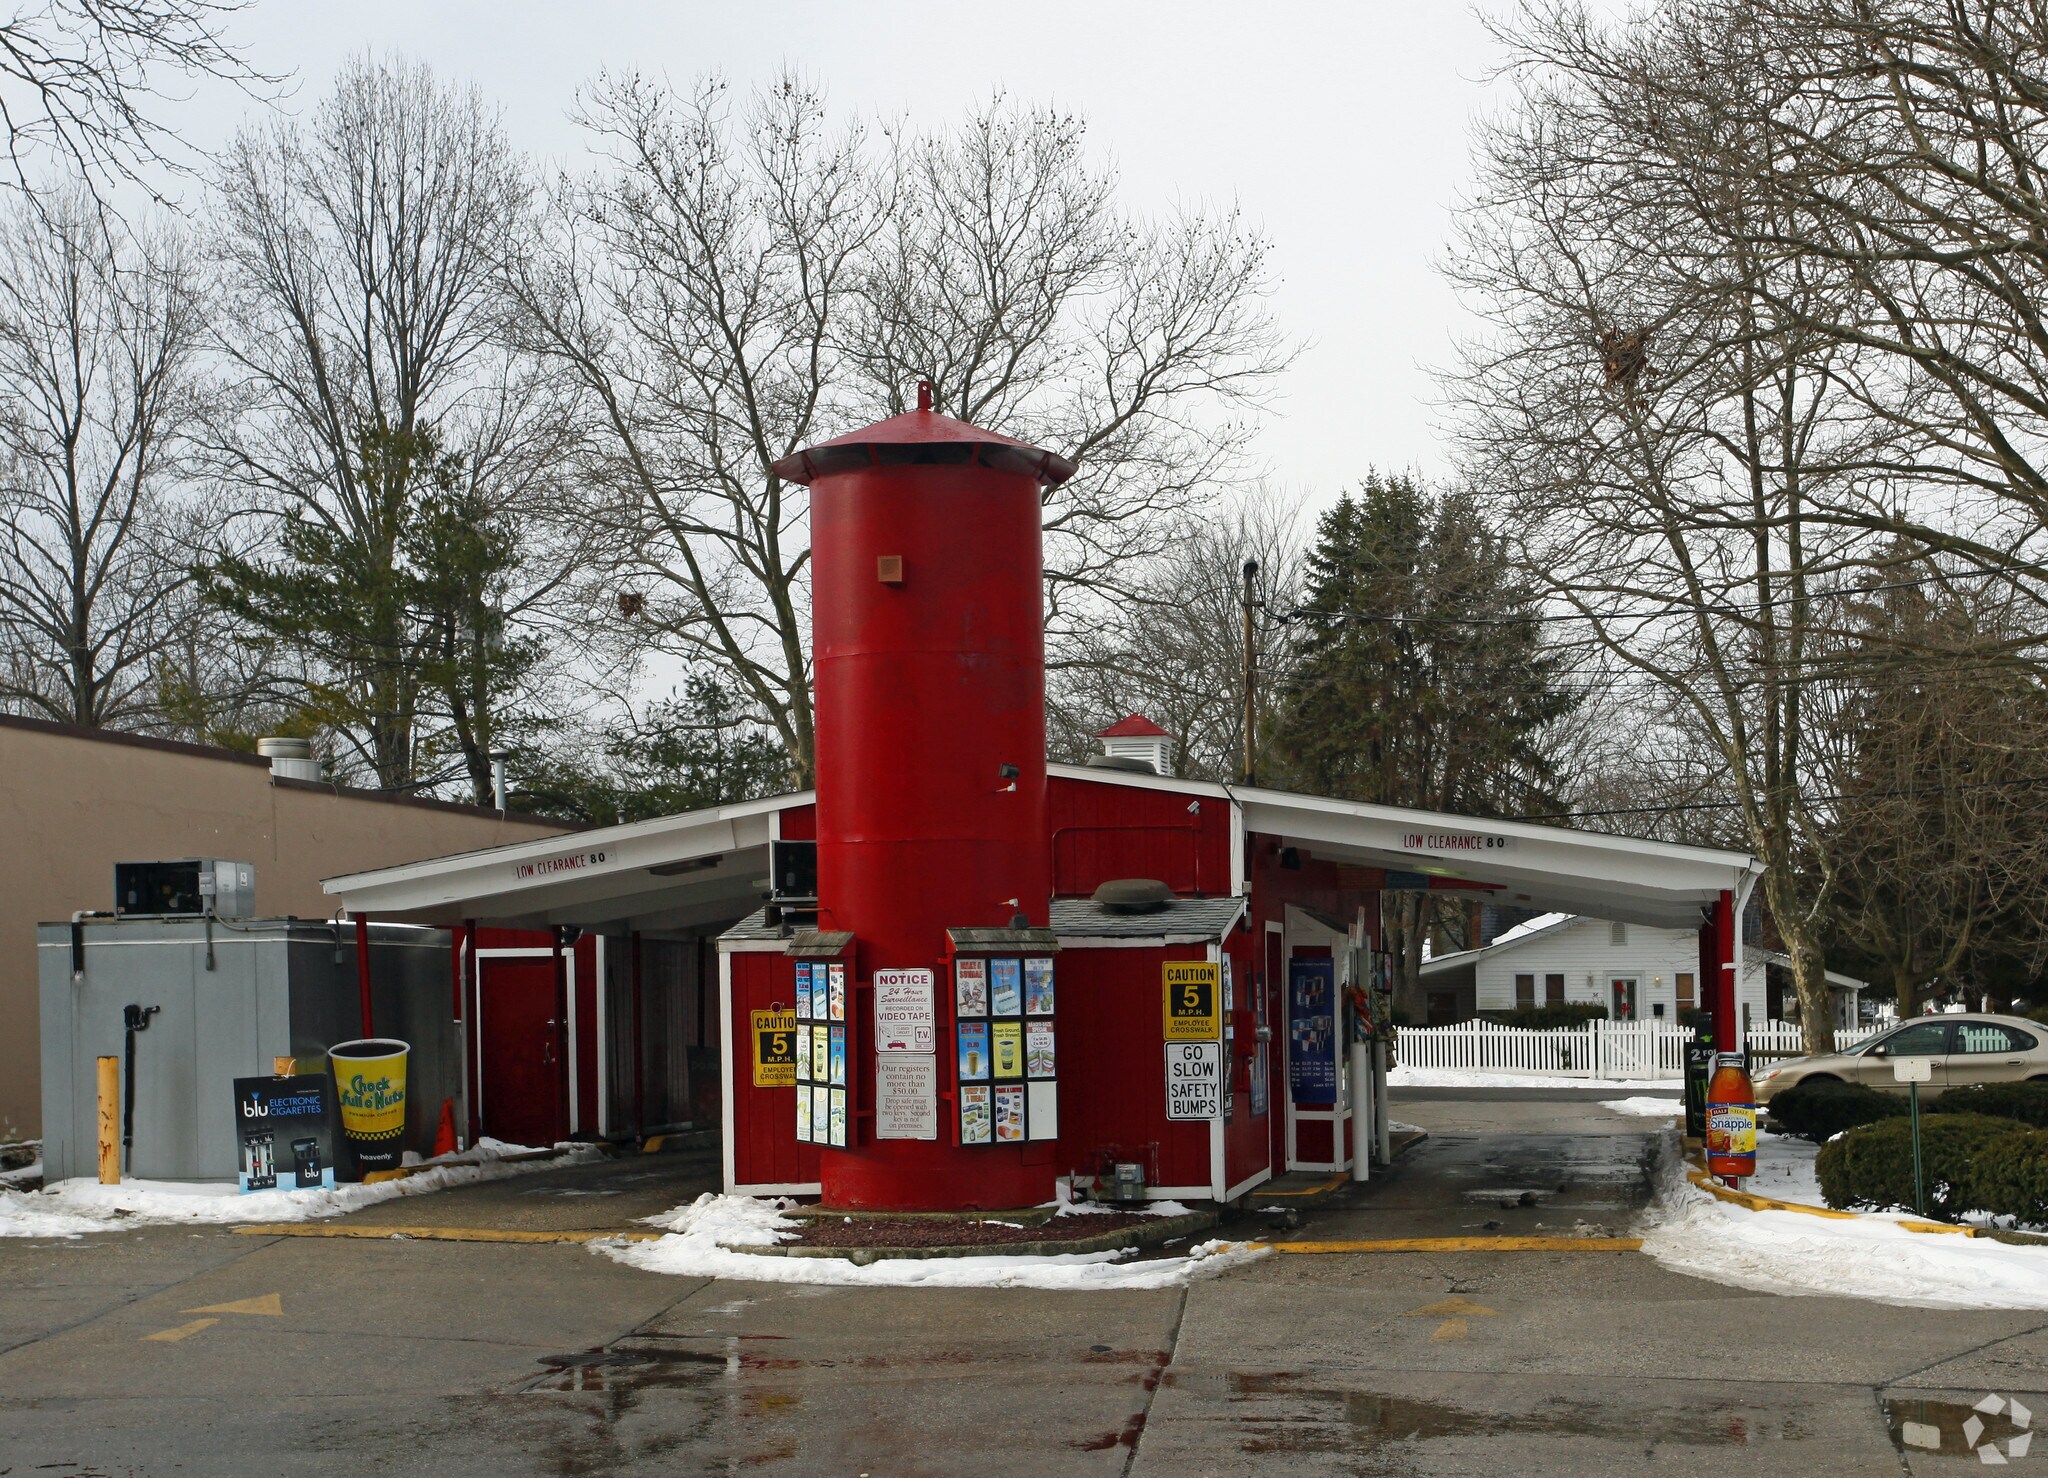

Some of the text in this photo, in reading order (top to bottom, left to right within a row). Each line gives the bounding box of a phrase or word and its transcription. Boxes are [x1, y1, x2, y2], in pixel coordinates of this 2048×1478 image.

[1404, 834, 1423, 848] LOW
[1428, 835, 1482, 849] CLEARANCE
[516, 864, 534, 879] LOW
[537, 854, 586, 874] CLEARANCE
[880, 975, 928, 984] NOTICE
[1168, 969, 1214, 981] CAUTION
[1183, 986, 1199, 1007] 5
[757, 1017, 794, 1029] CAUTIO
[772, 1034, 788, 1054] 5
[1183, 1046, 1203, 1060] GO
[1691, 1049, 1700, 1061] 2
[899, 1065, 930, 1074] registers
[1173, 1063, 1214, 1077] SLOW
[351, 1074, 390, 1096] Chock
[1171, 1083, 1217, 1098] SAFETY
[270, 1096, 320, 1107] ELECTRONIC
[375, 1090, 404, 1110] Nuts
[1174, 1100, 1216, 1114] BUMPS
[243, 1100, 268, 1118] blu
[270, 1105, 321, 1116] CIGARETTES
[1710, 1117, 1752, 1131] Snapple
[305, 1168, 319, 1178] blu
